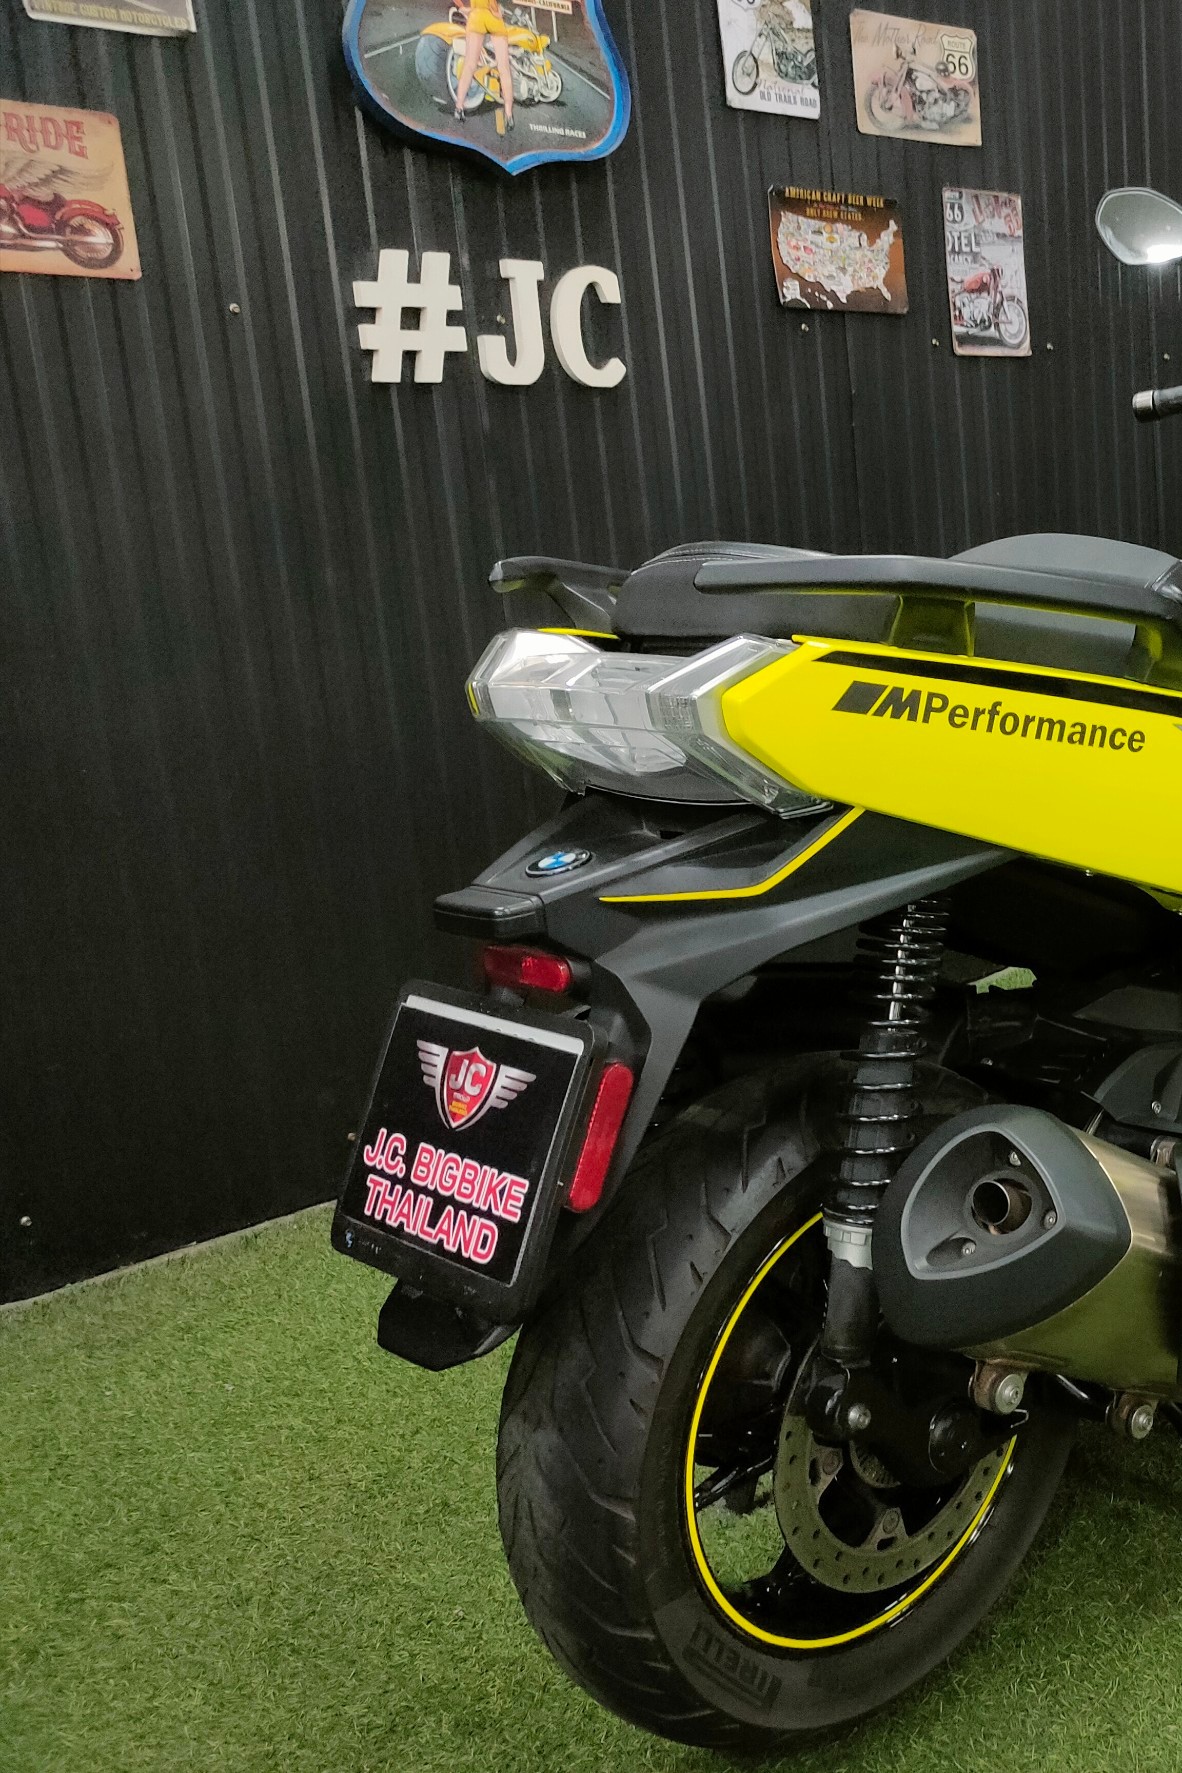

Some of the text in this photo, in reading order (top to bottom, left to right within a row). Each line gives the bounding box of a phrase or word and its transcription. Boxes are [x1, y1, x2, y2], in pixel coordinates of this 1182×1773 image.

[119, 8, 189, 30] MOTORCYCLES
[945, 53, 970, 76] 66
[759, 90, 772, 102] OLD
[799, 95, 818, 109] ROAD
[2, 111, 89, 160] RIDE
[785, 186, 821, 201] AMERICAN
[946, 202, 963, 223] 66
[352, 248, 627, 388] #JC
[449, 1058, 487, 1096] JC
[363, 1127, 530, 1224] J.C. BIGBIKE
[363, 1173, 499, 1265] THAILAND
